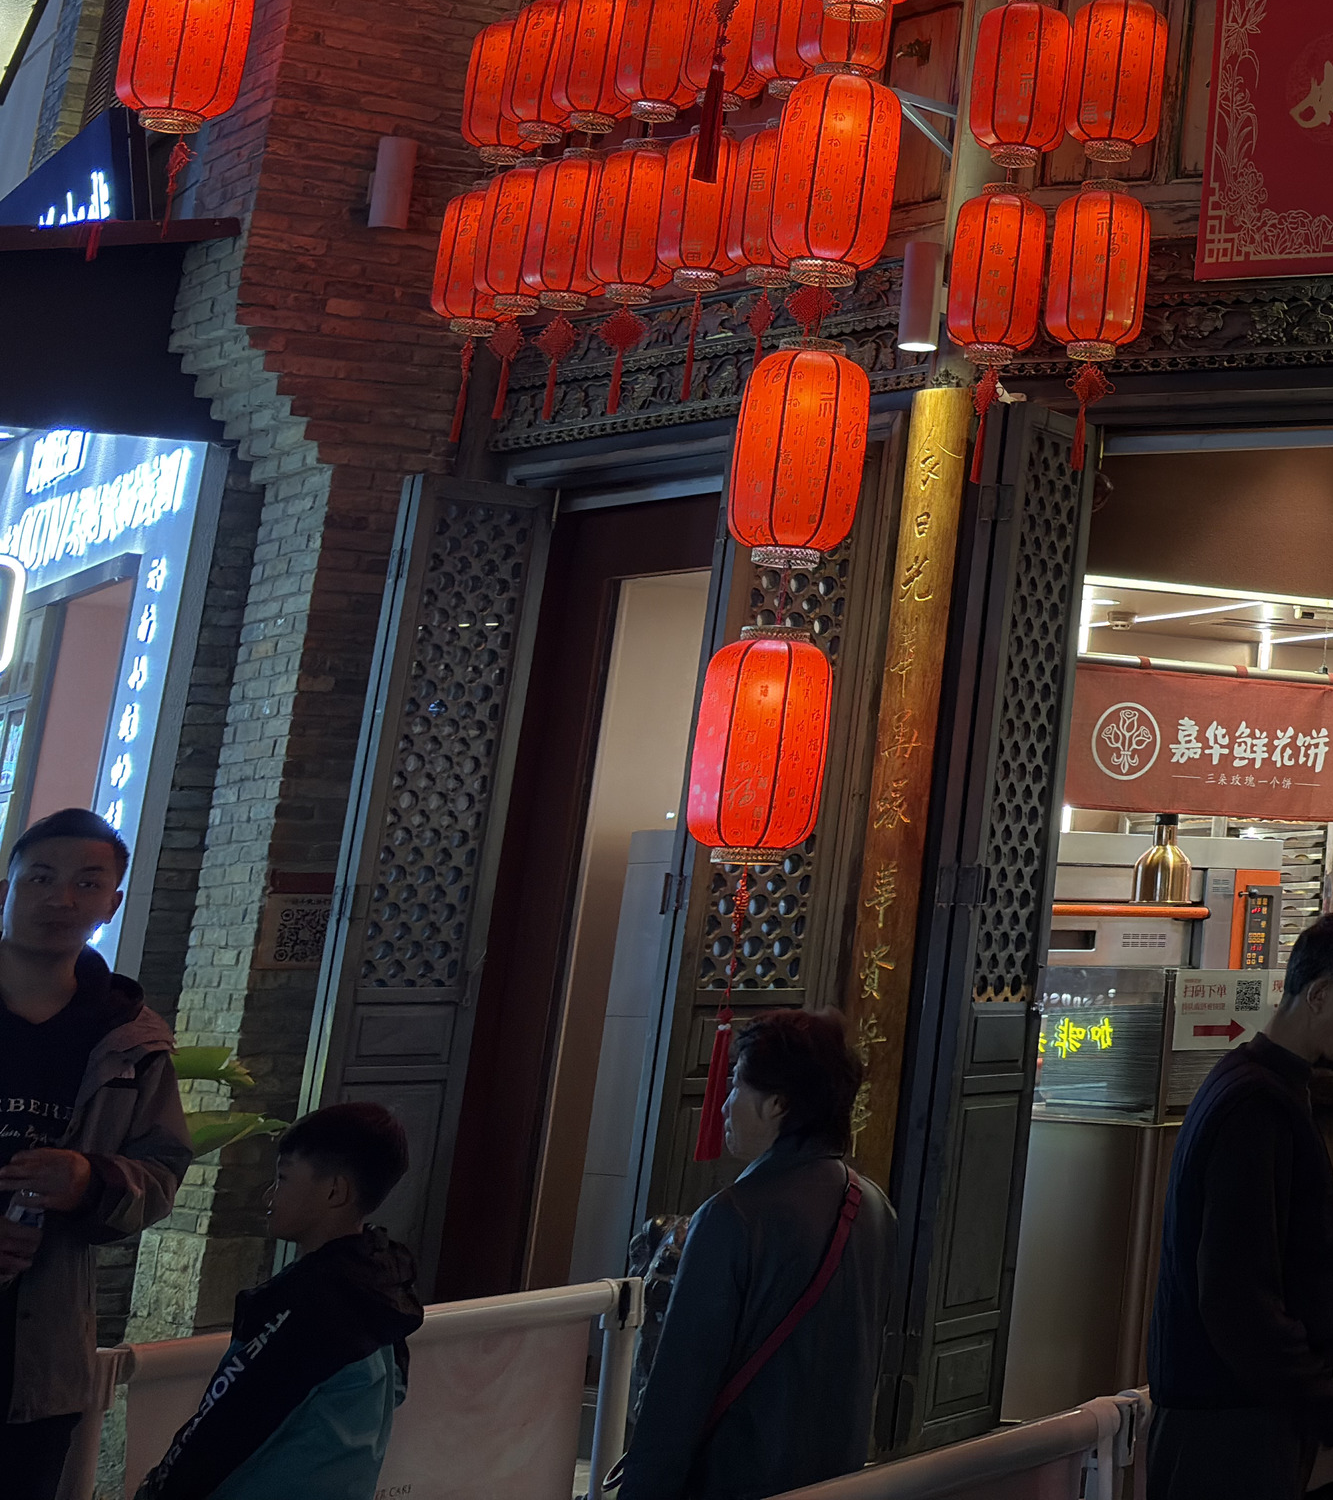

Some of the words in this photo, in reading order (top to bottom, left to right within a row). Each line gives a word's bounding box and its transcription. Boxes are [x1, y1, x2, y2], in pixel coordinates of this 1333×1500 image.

[1168, 716, 1330, 773] 嘉华鲜花饼
[1204, 773, 1292, 789] 三朵玫瑰一个饼
[1183, 984, 1227, 999] 扫码下单
